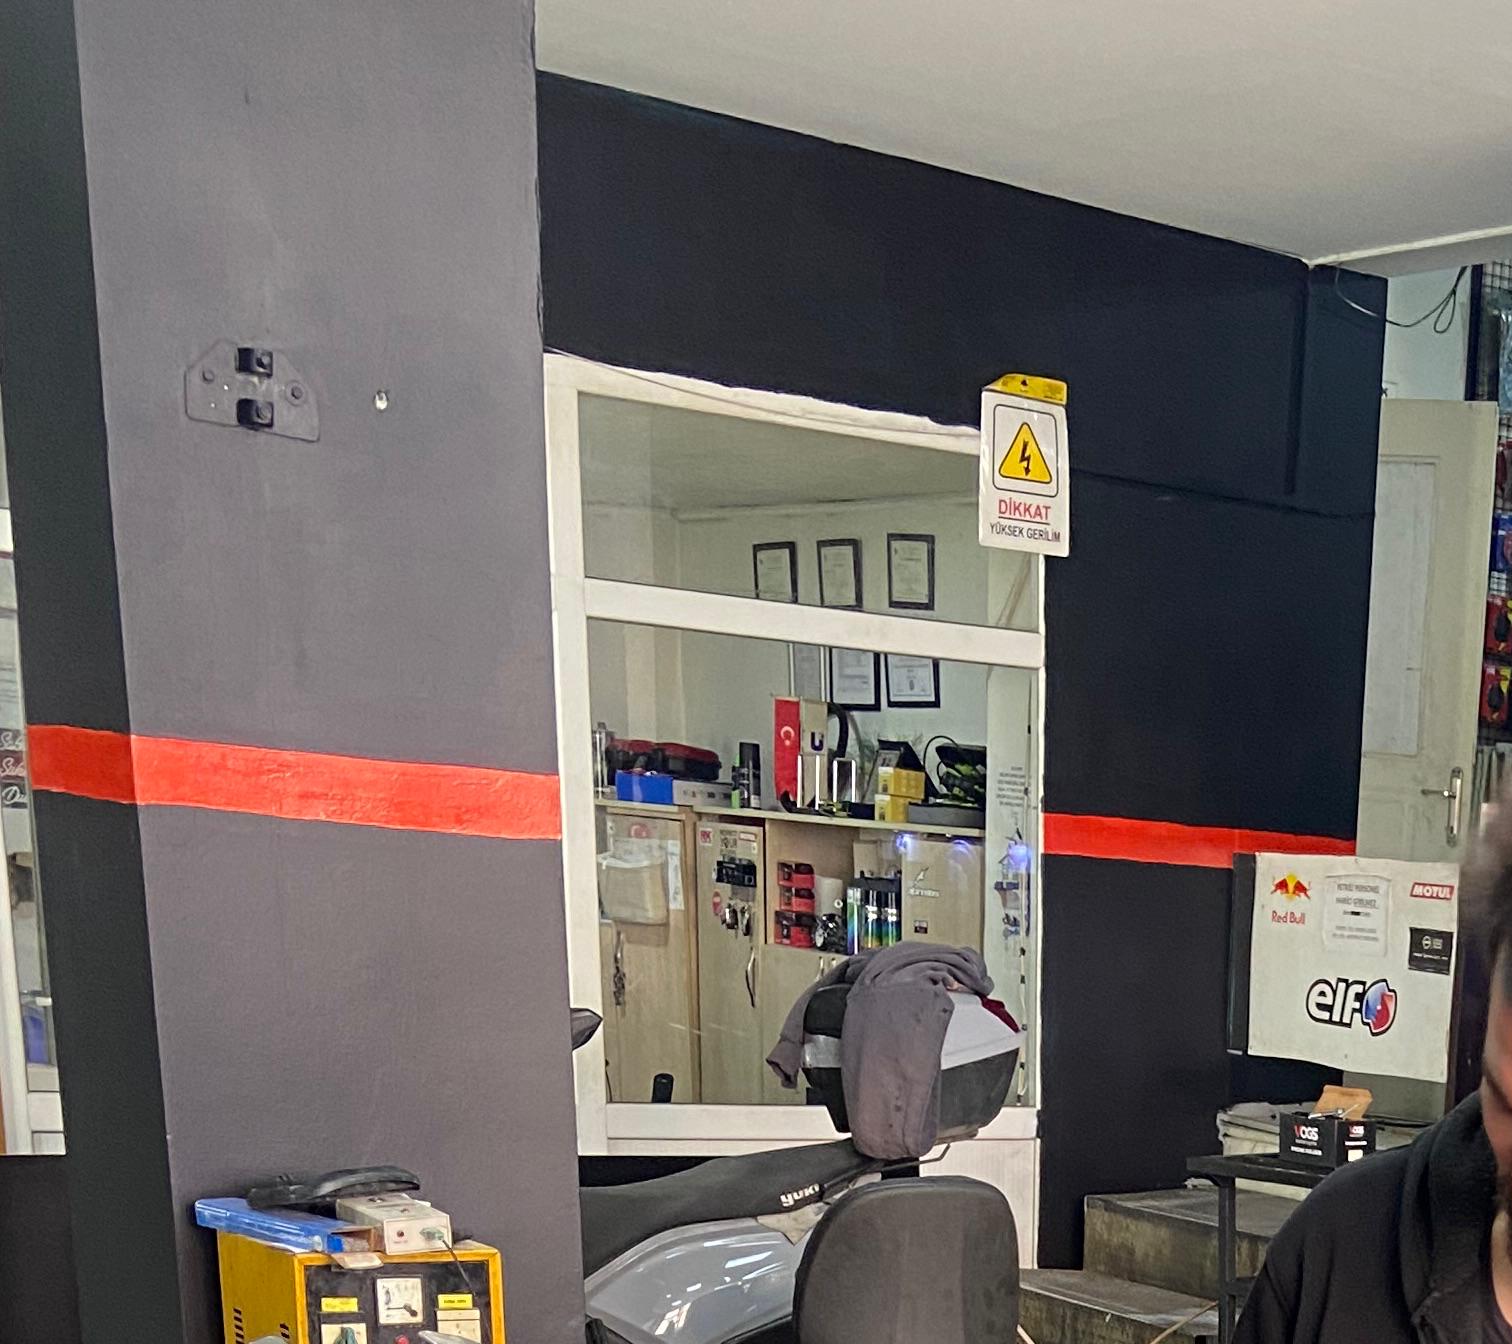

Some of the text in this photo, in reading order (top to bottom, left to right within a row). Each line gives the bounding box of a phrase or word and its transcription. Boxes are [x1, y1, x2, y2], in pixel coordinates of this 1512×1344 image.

[998, 496, 1052, 521] DİKKAT
[989, 521, 1061, 543] YÜKSEK GERİLİM
[1412, 884, 1452, 898] MOTUL
[1271, 910, 1306, 925] Red Bull
[1306, 978, 1367, 1028] elf
